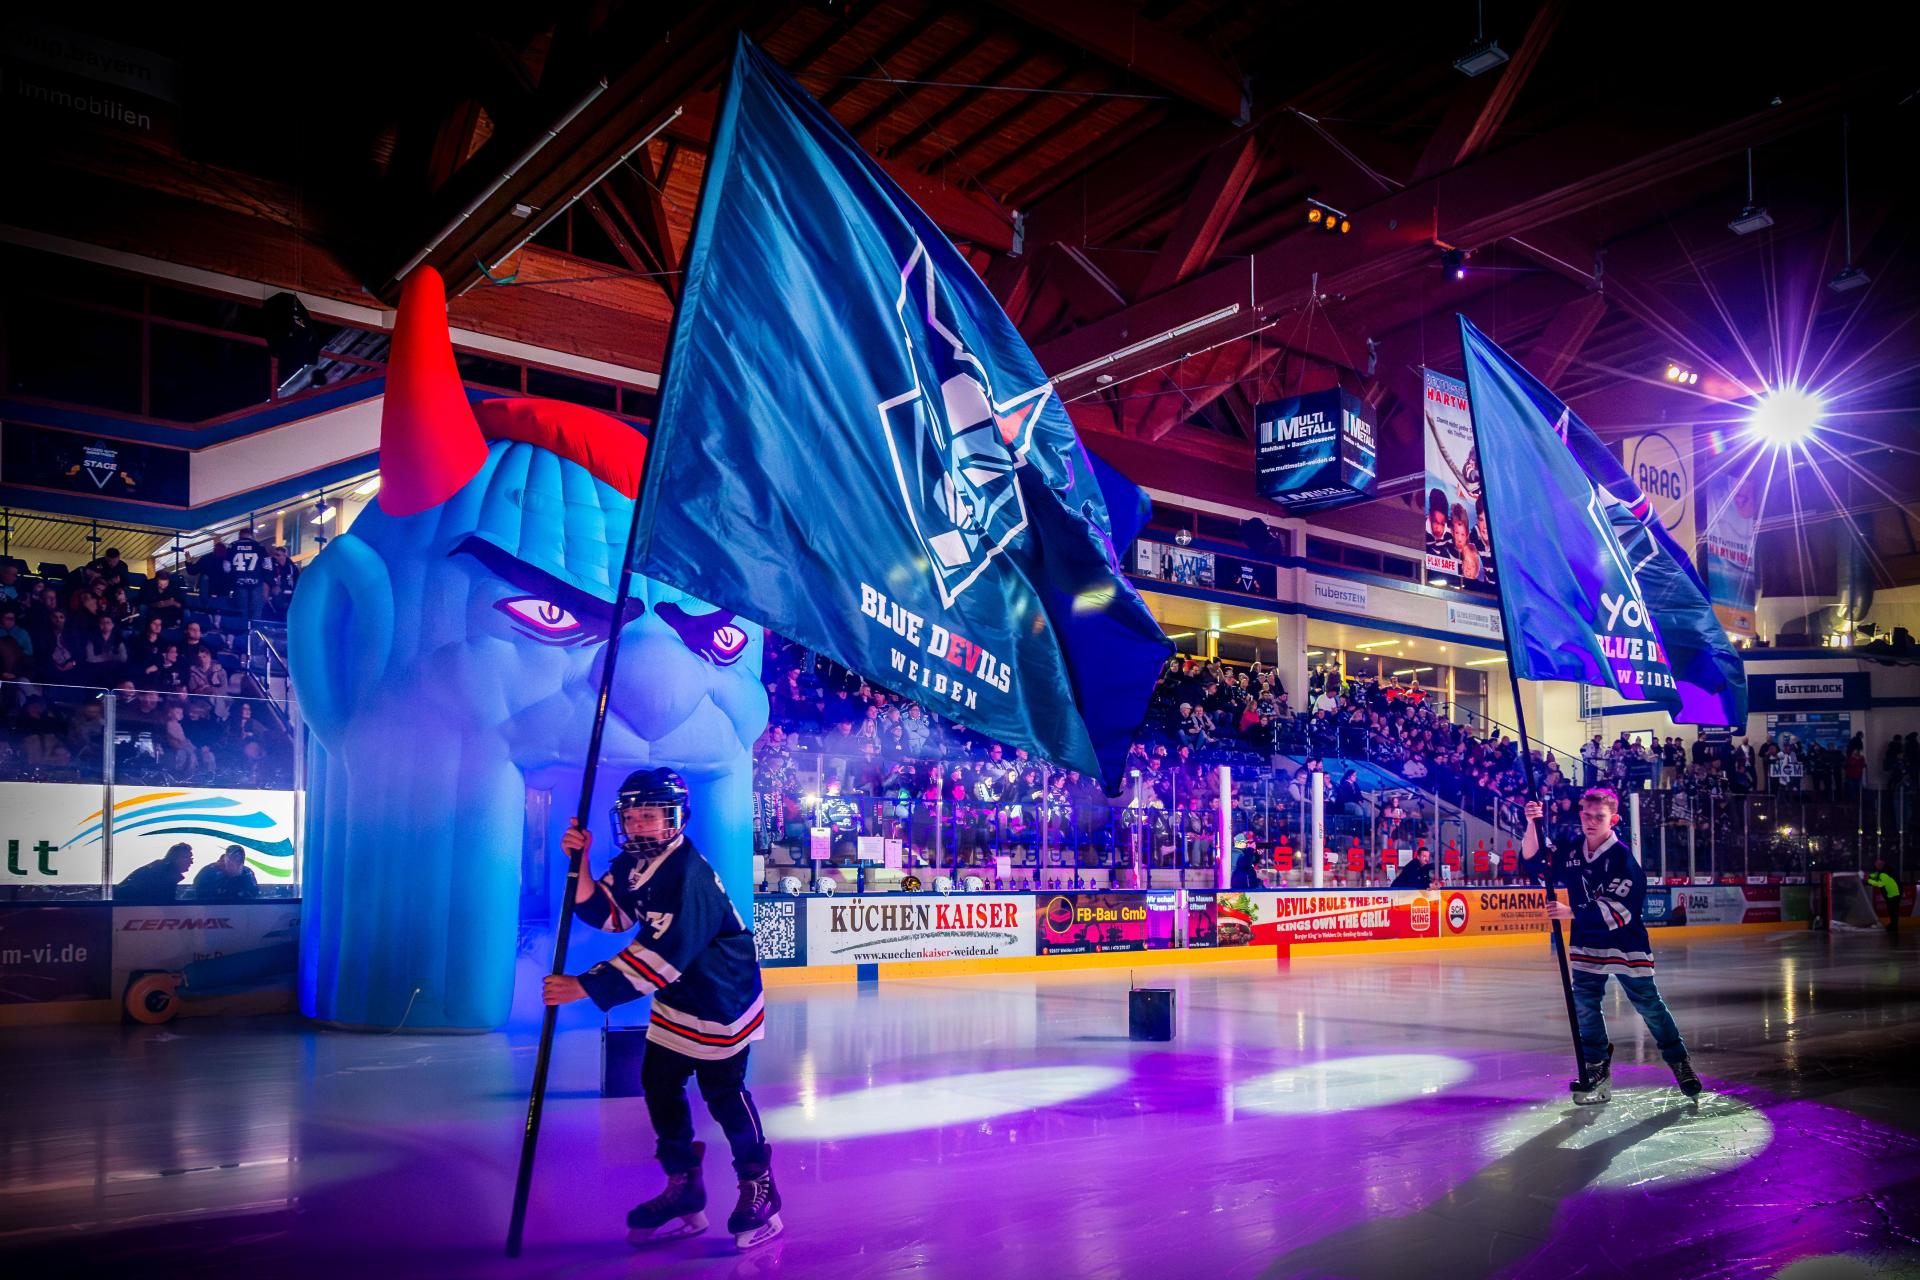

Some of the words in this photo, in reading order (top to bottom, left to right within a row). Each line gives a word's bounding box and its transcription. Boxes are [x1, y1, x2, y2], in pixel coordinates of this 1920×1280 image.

[83, 460, 118, 471] STAGE
[1639, 462, 1681, 500] ARAG
[232, 552, 259, 572] 47
[1442, 559, 1456, 571] SAFE
[1314, 583, 1367, 603] huberSTEIN
[860, 581, 925, 648] BLUE
[926, 623, 1012, 694] DEVILS
[890, 647, 978, 710] WEIDEN
[1777, 683, 1843, 694] GÄSTEBLOCK
[1277, 897, 1317, 918] DEVILS
[1318, 897, 1347, 912] RULE
[1348, 897, 1371, 908] THE
[1371, 896, 1389, 905] ICE
[1450, 905, 1464, 913] SCH
[1689, 894, 1709, 909] RAAB
[830, 898, 930, 933] KÜCHEN
[935, 903, 1019, 930] KAISER
[1077, 907, 1117, 922] FB-Bau
[1276, 920, 1311, 931] KINGS
[1312, 915, 1336, 930] OWN
[1338, 911, 1359, 929] THE
[1360, 909, 1391, 928] GRILL
[1411, 914, 1430, 923] KING
[854, 945, 999, 961] www.kuechenkaiser-weiden.de
